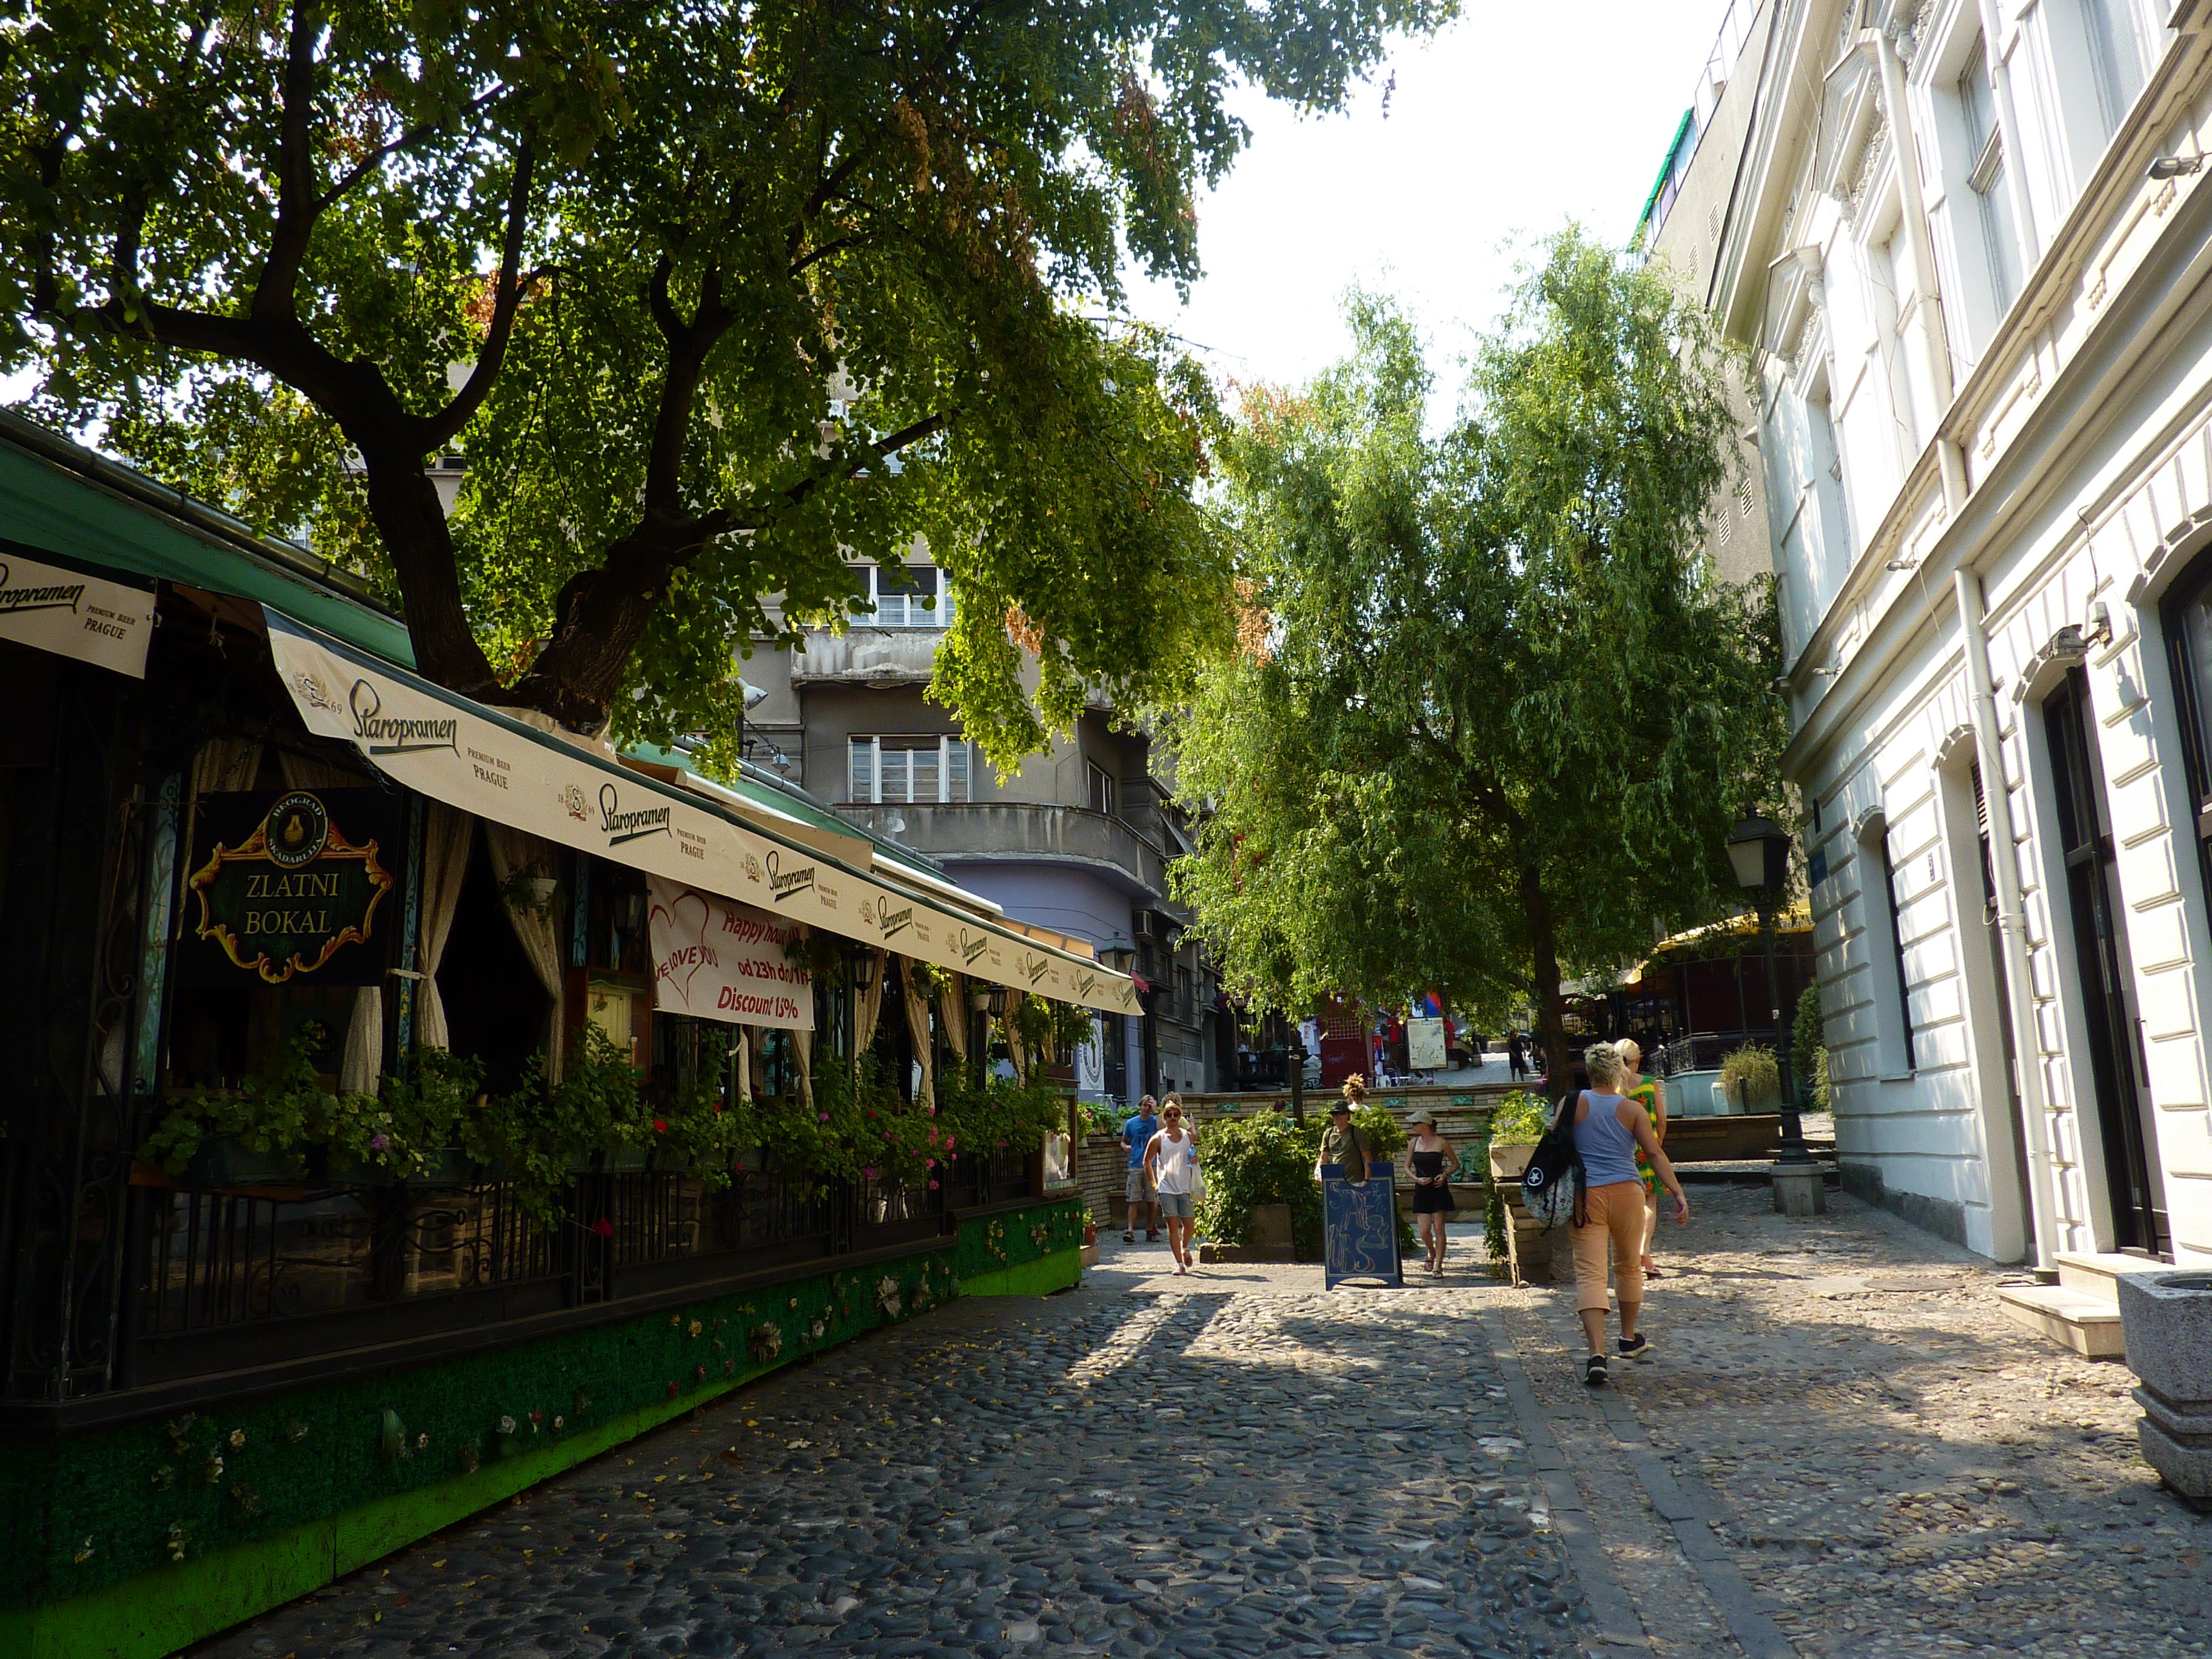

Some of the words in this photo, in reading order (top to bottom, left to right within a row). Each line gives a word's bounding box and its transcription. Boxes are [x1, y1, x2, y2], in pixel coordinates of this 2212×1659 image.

[0, 563, 85, 614] ropramen
[86, 605, 115, 620] PREMIUM
[116, 614, 135, 625] BEER
[84, 617, 126, 640] PRAGUE
[349, 679, 461, 759] Staropramen
[467, 747, 495, 766] PREMIUM
[496, 760, 511, 772] BEER
[473, 764, 509, 789] PRAGUE
[273, 797, 322, 817] BEOGRAD
[599, 783, 672, 839] Staropramen
[680, 841, 705, 860] PRAGUE
[766, 851, 815, 893] Staropramen
[245, 873, 339, 898] ZLATNI
[244, 911, 332, 934] BOKAL
[722, 910, 765, 945] Happy
[669, 946, 697, 971] LOVE
[737, 958, 754, 977] od
[752, 960, 777, 980] 23h
[717, 986, 774, 1016] Discount
[774, 996, 799, 1019] 15%
